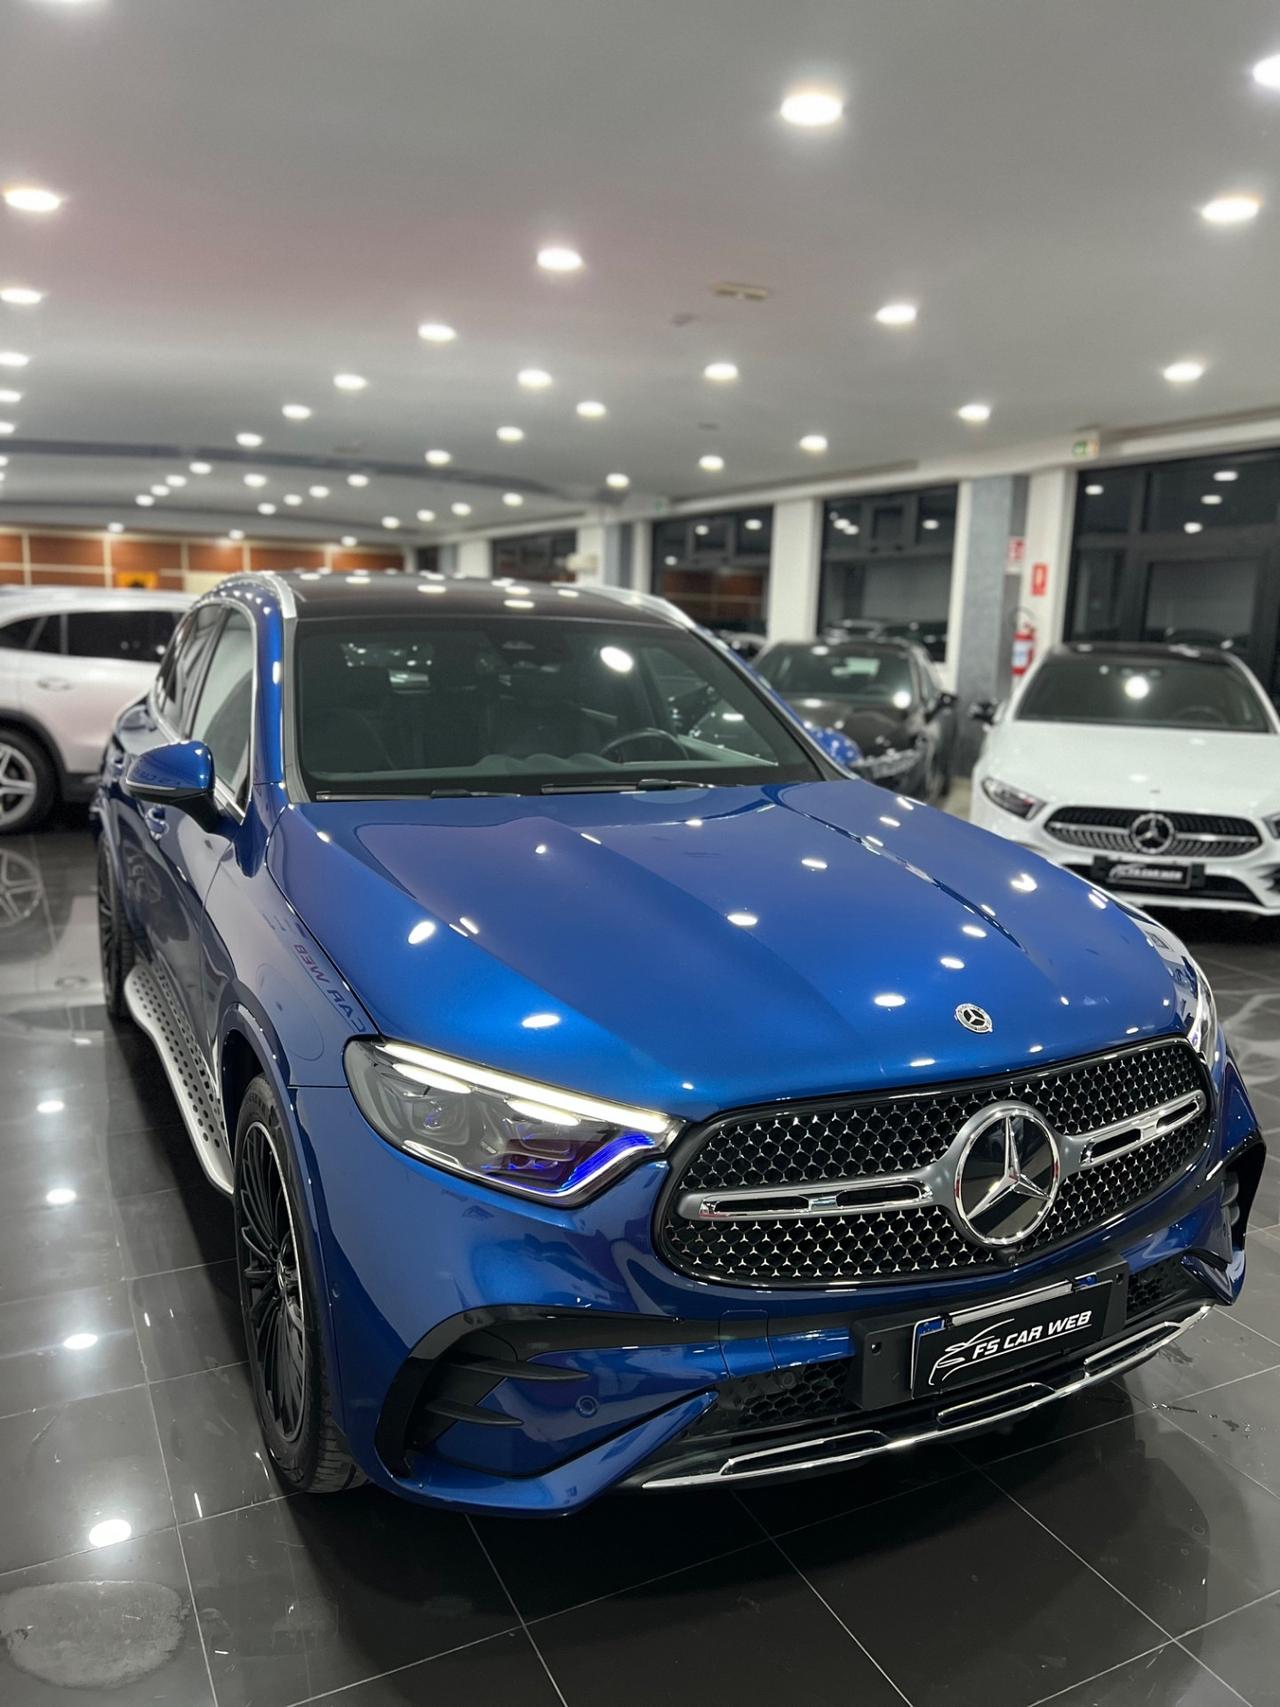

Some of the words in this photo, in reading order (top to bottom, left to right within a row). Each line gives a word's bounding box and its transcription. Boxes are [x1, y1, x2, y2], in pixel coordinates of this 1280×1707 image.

[972, 1339, 1001, 1360] FS
[1003, 1325, 1043, 1350] CAR
[1047, 1310, 1092, 1336] WEB
